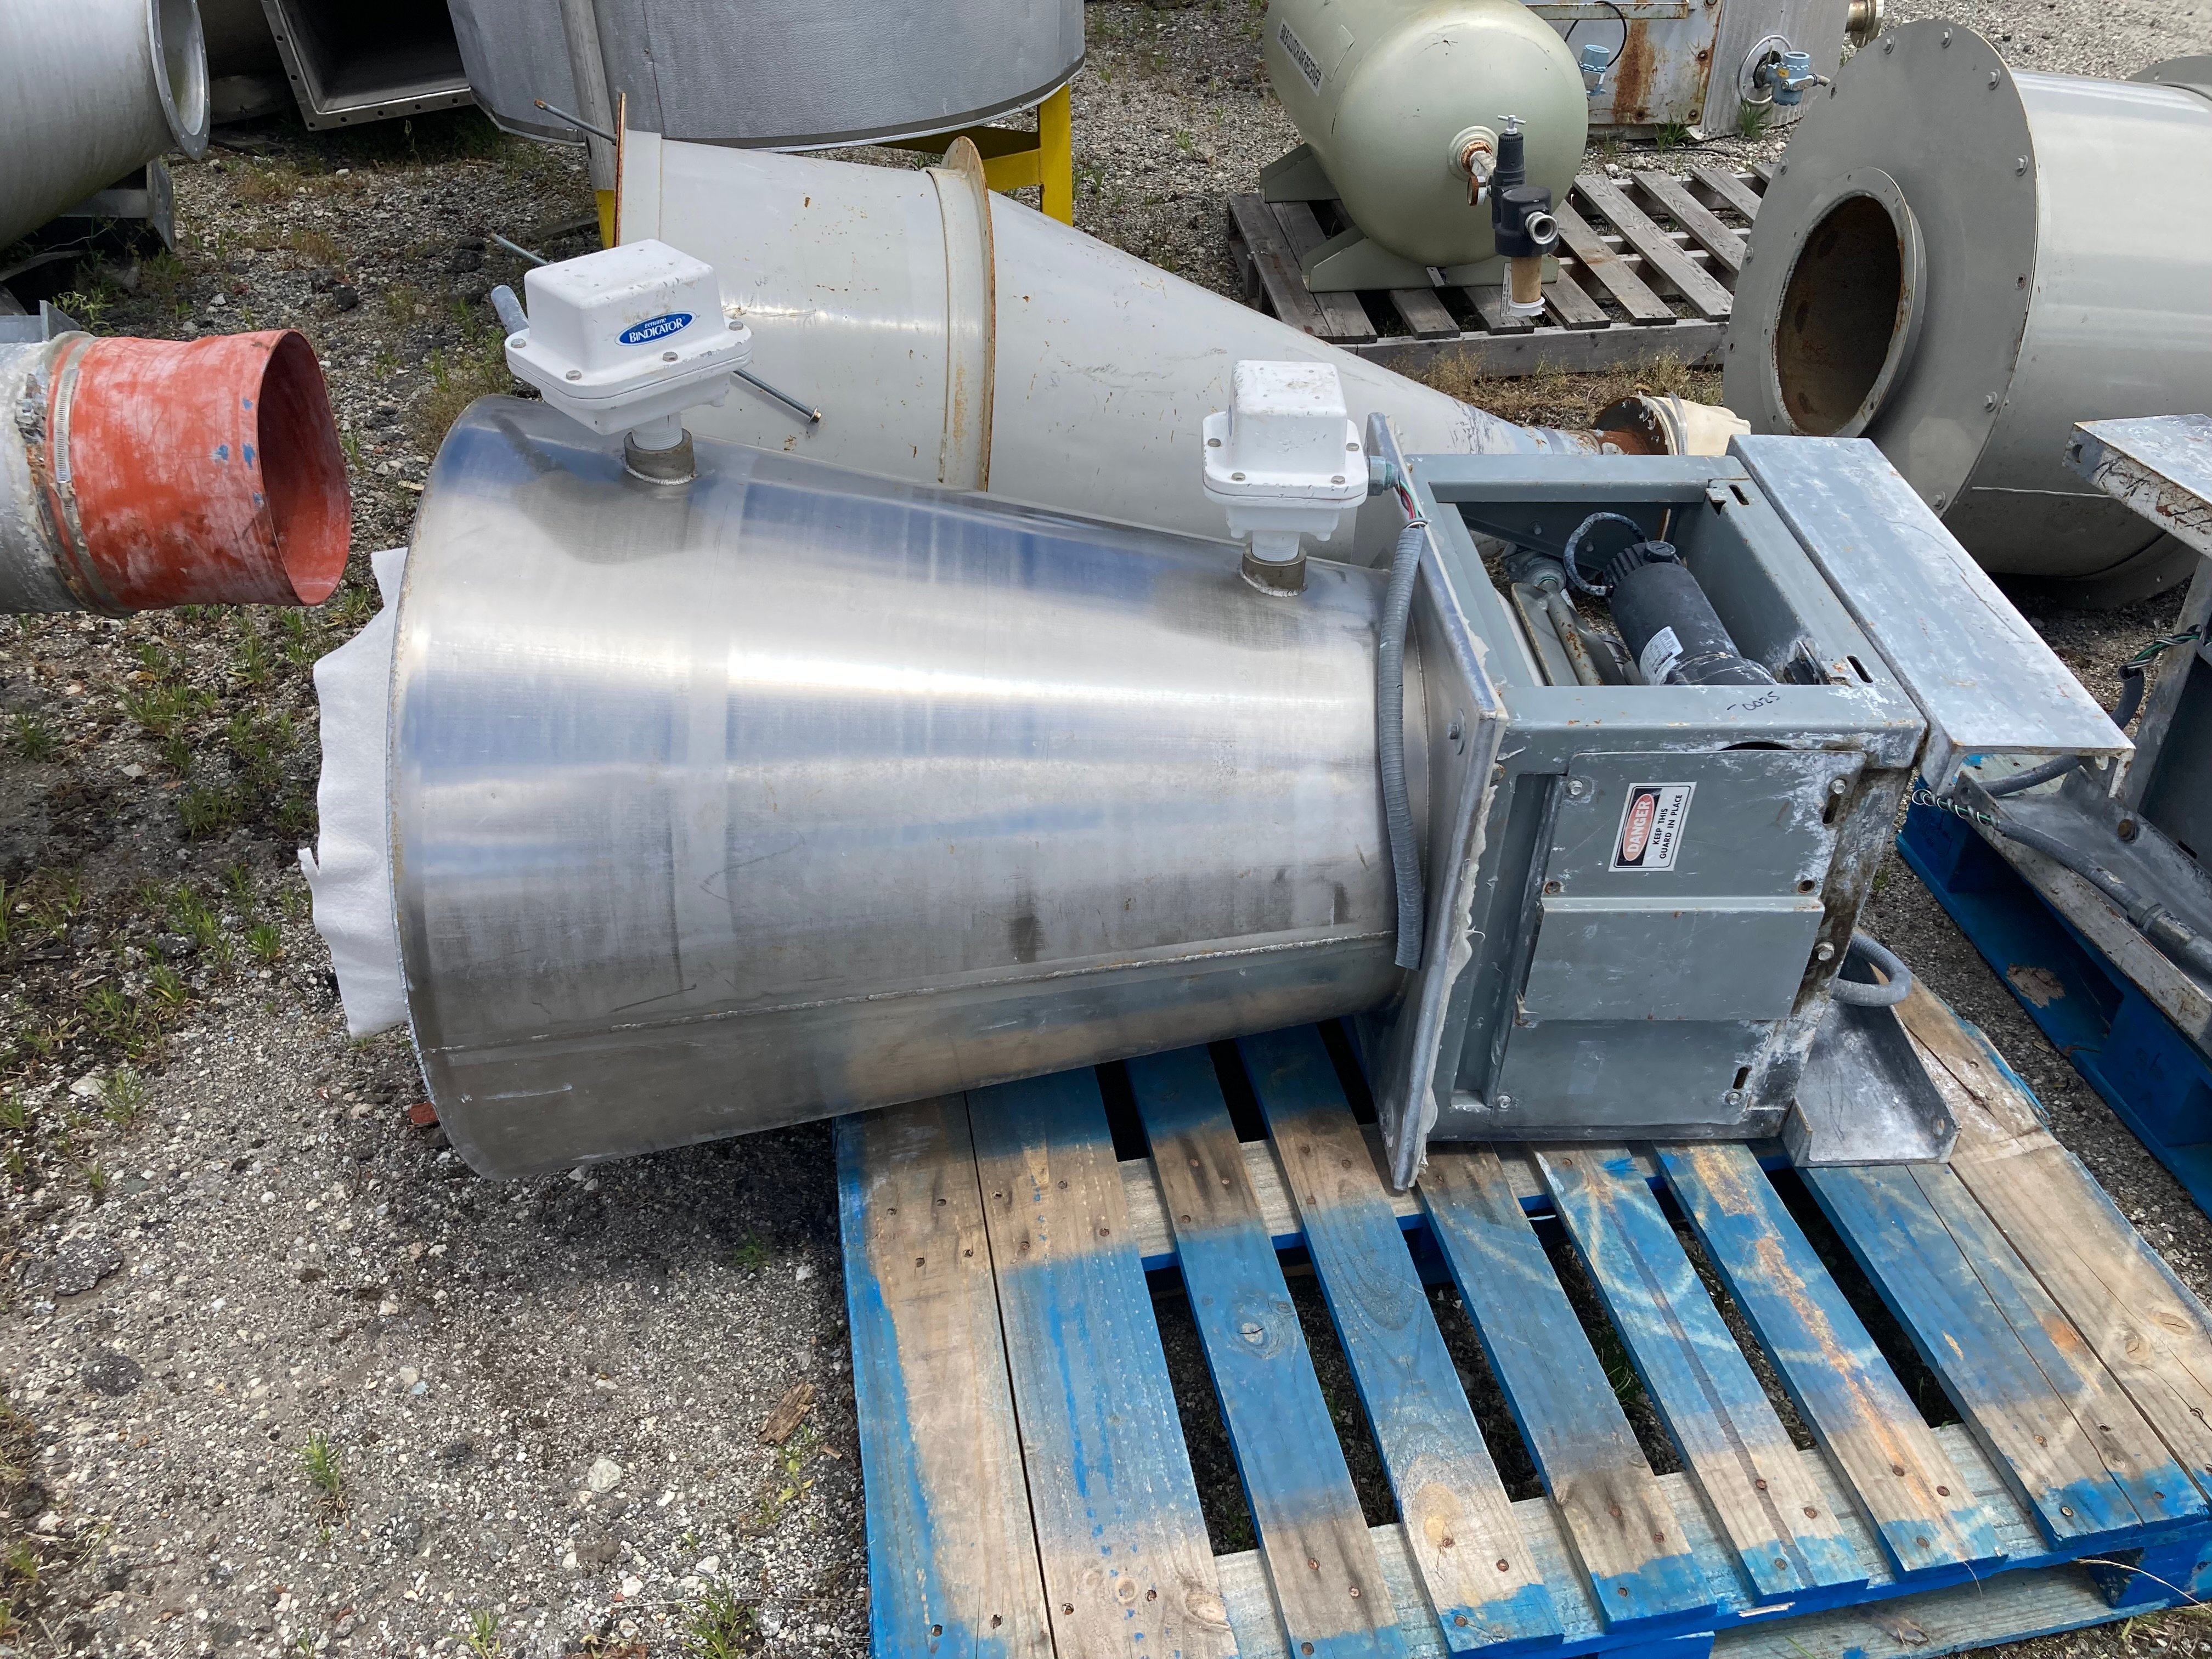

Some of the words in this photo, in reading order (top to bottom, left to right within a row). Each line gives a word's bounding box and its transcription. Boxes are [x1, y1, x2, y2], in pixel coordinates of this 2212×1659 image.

[1286, 33, 1301, 61] CLUTCH
[1297, 48, 1306, 68] AIR
[1303, 55, 1321, 89] RECEIVER
[629, 318, 684, 343] BINDICATOR
[1627, 800, 1651, 853] DANGER
[1652, 828, 1662, 845] KEEP
[1658, 808, 1668, 824] THIS
[1660, 832, 1672, 859] GUARD
[1667, 820, 1675, 828] IN
[1671, 794, 1683, 816] PLACE
